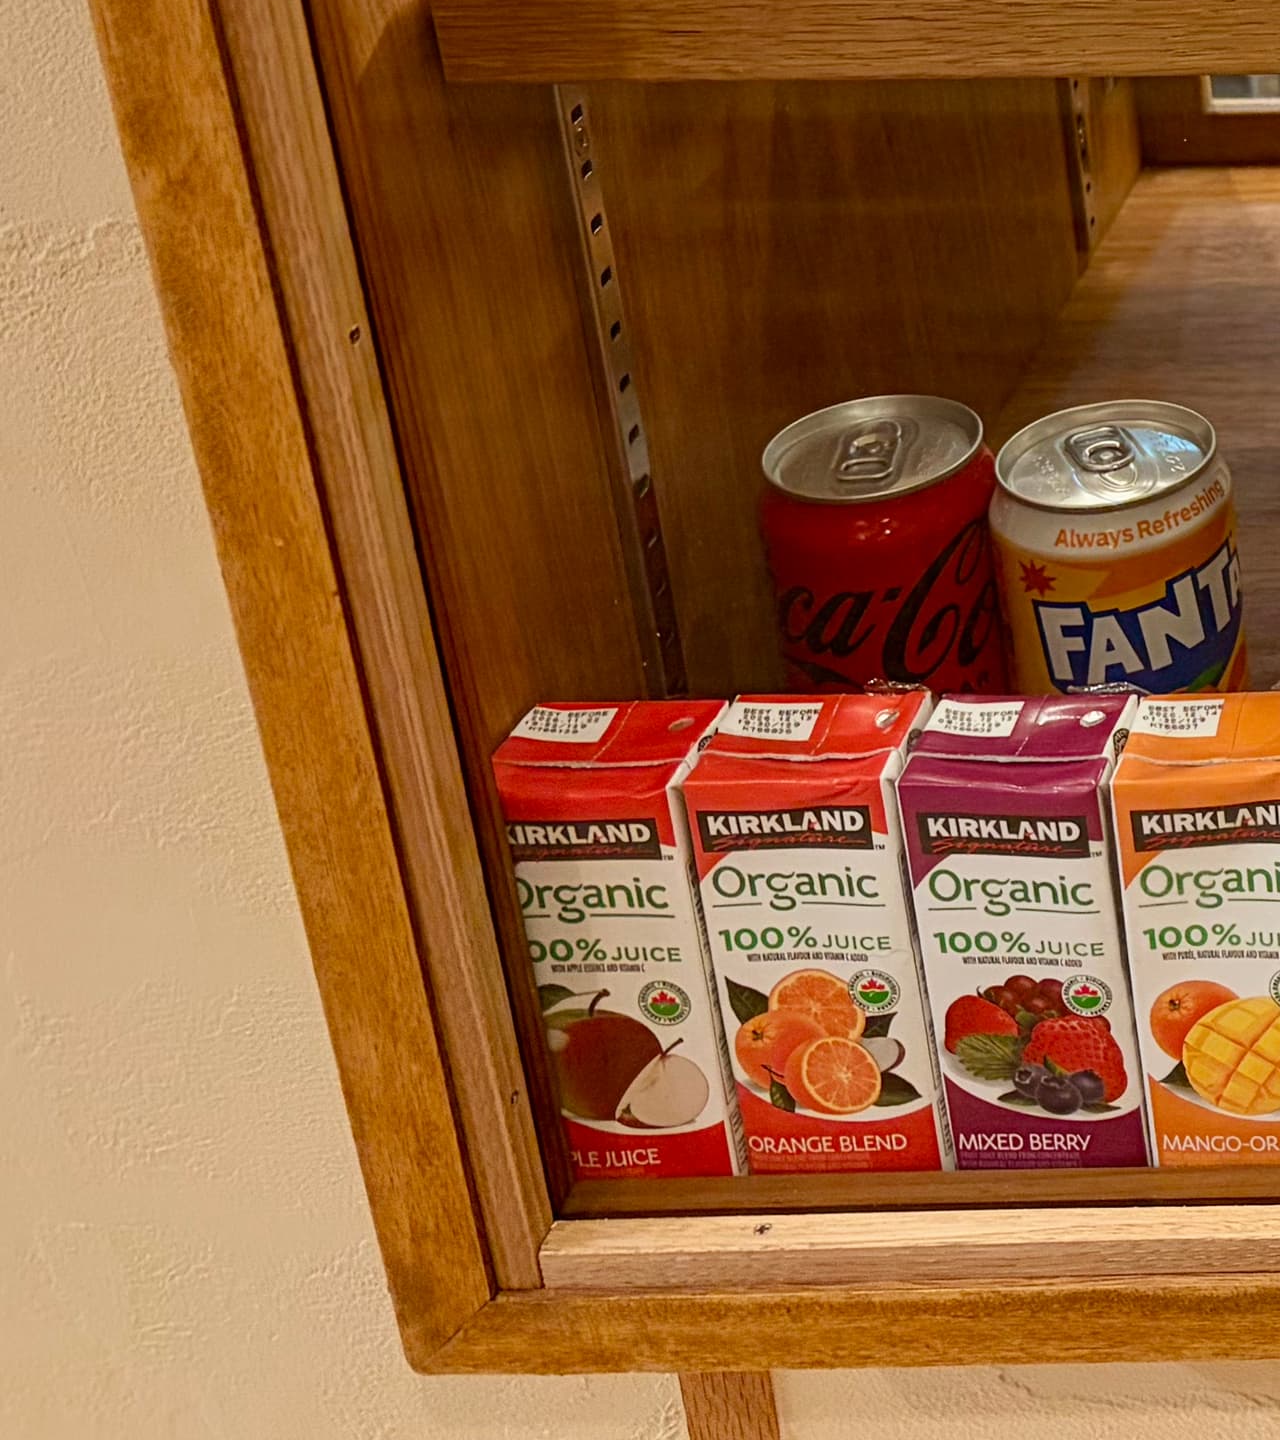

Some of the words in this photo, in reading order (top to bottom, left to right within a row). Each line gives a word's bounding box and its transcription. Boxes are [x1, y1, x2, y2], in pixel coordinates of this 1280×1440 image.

[1054, 523, 1135, 549] Always
[1136, 478, 1227, 541] Refreshing
[706, 810, 865, 836] KIRKLAND
[927, 817, 1081, 843] KIRKLAND
[711, 832, 868, 852] Signature
[931, 837, 1084, 855] Signature
[712, 865, 880, 911] Organic
[928, 869, 1095, 917] Organic
[718, 926, 818, 952] 100%
[822, 935, 893, 952] JUICE
[933, 931, 1030, 955] 100%
[1035, 940, 1105, 957] JUICE
[1142, 923, 1241, 950] 100%
[611, 946, 683, 963] JUICE
[748, 1135, 836, 1156] ORANGE
[840, 1133, 908, 1154] BLEND
[958, 1133, 1024, 1151] MIXED
[1028, 1133, 1091, 1152] BERRY
[604, 1148, 662, 1168] JUICE
